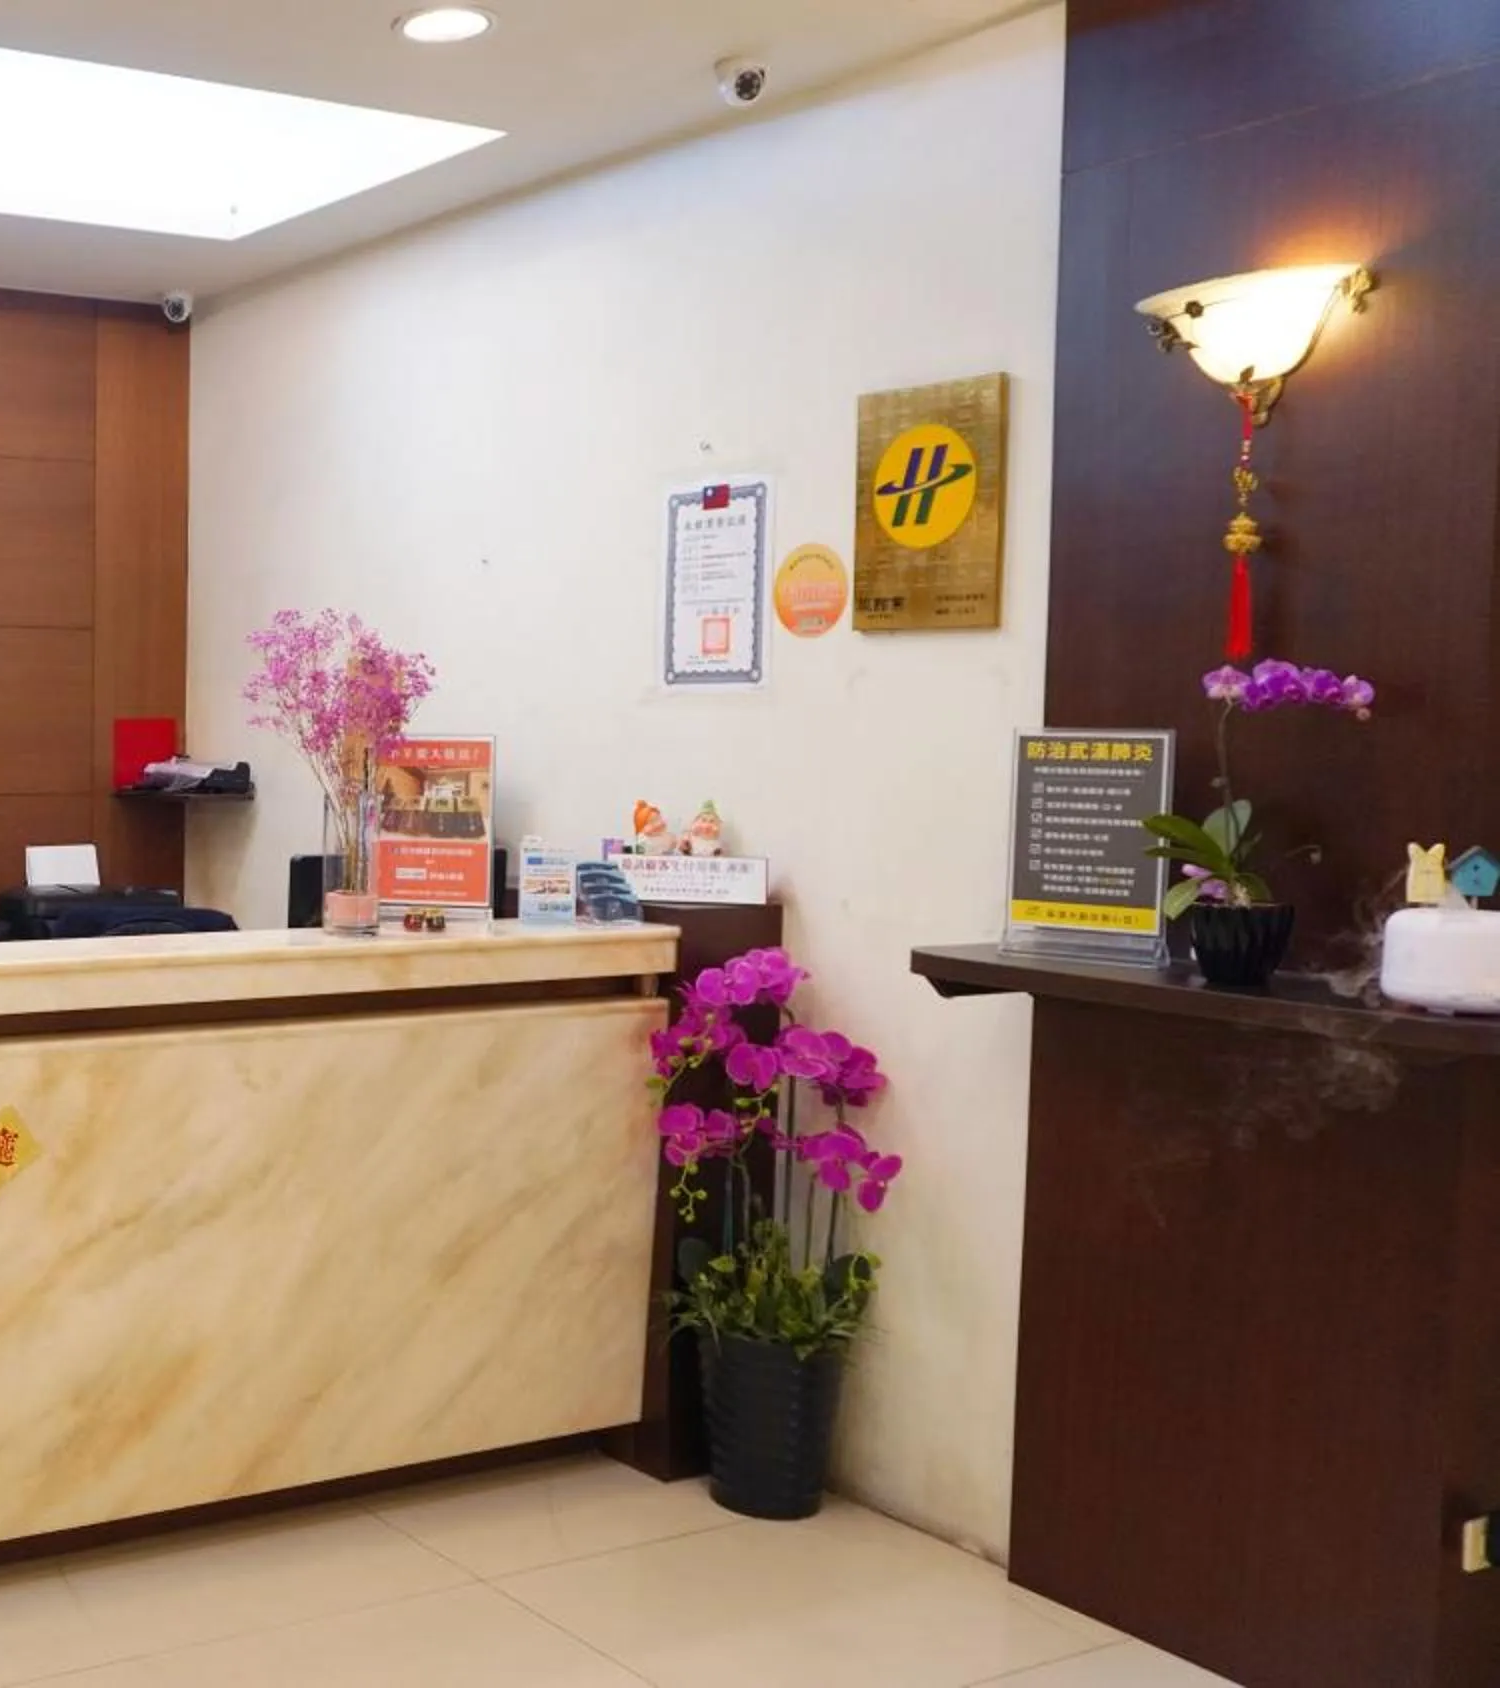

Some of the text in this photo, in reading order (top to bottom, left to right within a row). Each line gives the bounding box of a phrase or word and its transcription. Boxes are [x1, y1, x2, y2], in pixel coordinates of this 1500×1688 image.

[1026, 740, 1154, 762] 防治武漢肺炎
